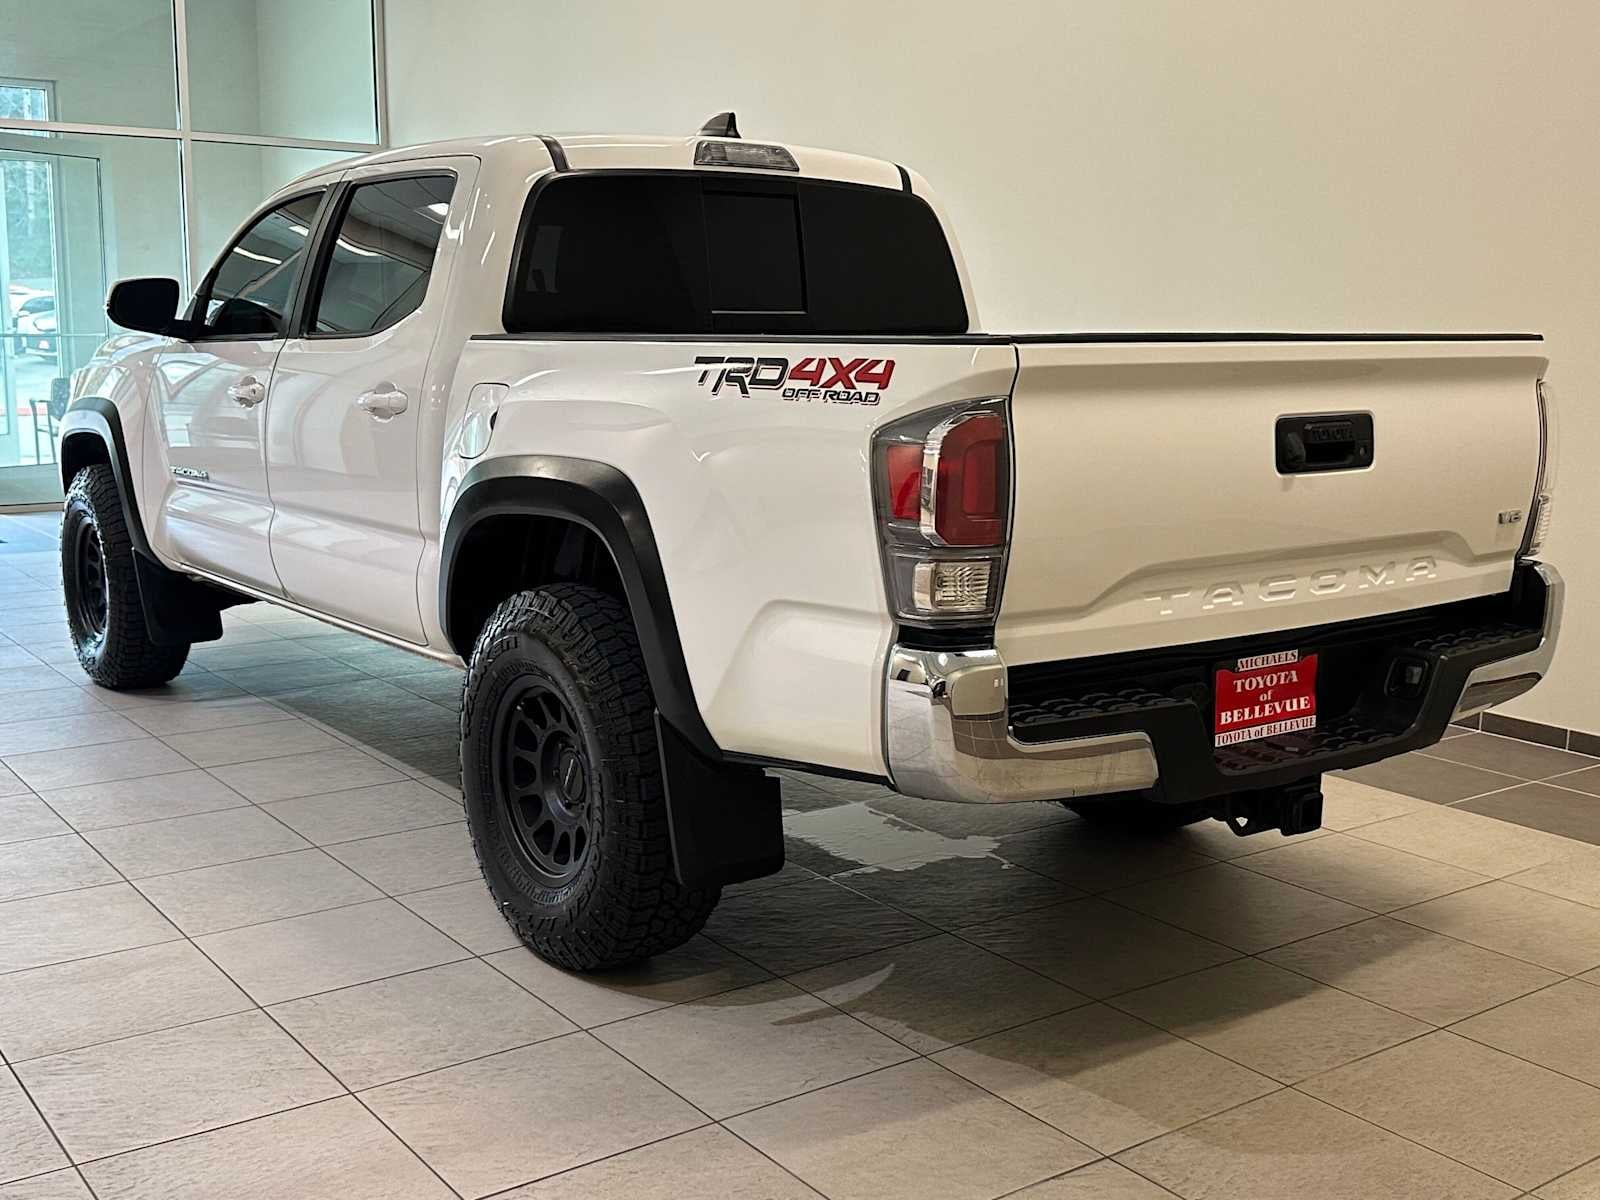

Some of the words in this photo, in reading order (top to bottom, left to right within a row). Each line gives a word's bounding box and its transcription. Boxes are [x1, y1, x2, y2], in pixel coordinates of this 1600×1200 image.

[694, 356, 789, 398] TRD
[788, 357, 896, 390] 4X4
[782, 387, 821, 401] OFF
[823, 389, 880, 406] ROAD
[1143, 555, 1437, 616] TACOMA
[1239, 651, 1298, 671] MICHAELS
[1233, 670, 1299, 693] TOYOTA
[1259, 689, 1274, 702] of
[1220, 696, 1311, 725] BELLEVUE
[1216, 728, 1252, 746] TOYOTA
[1254, 726, 1265, 738] of
[1266, 717, 1314, 736] BELLEVUE
